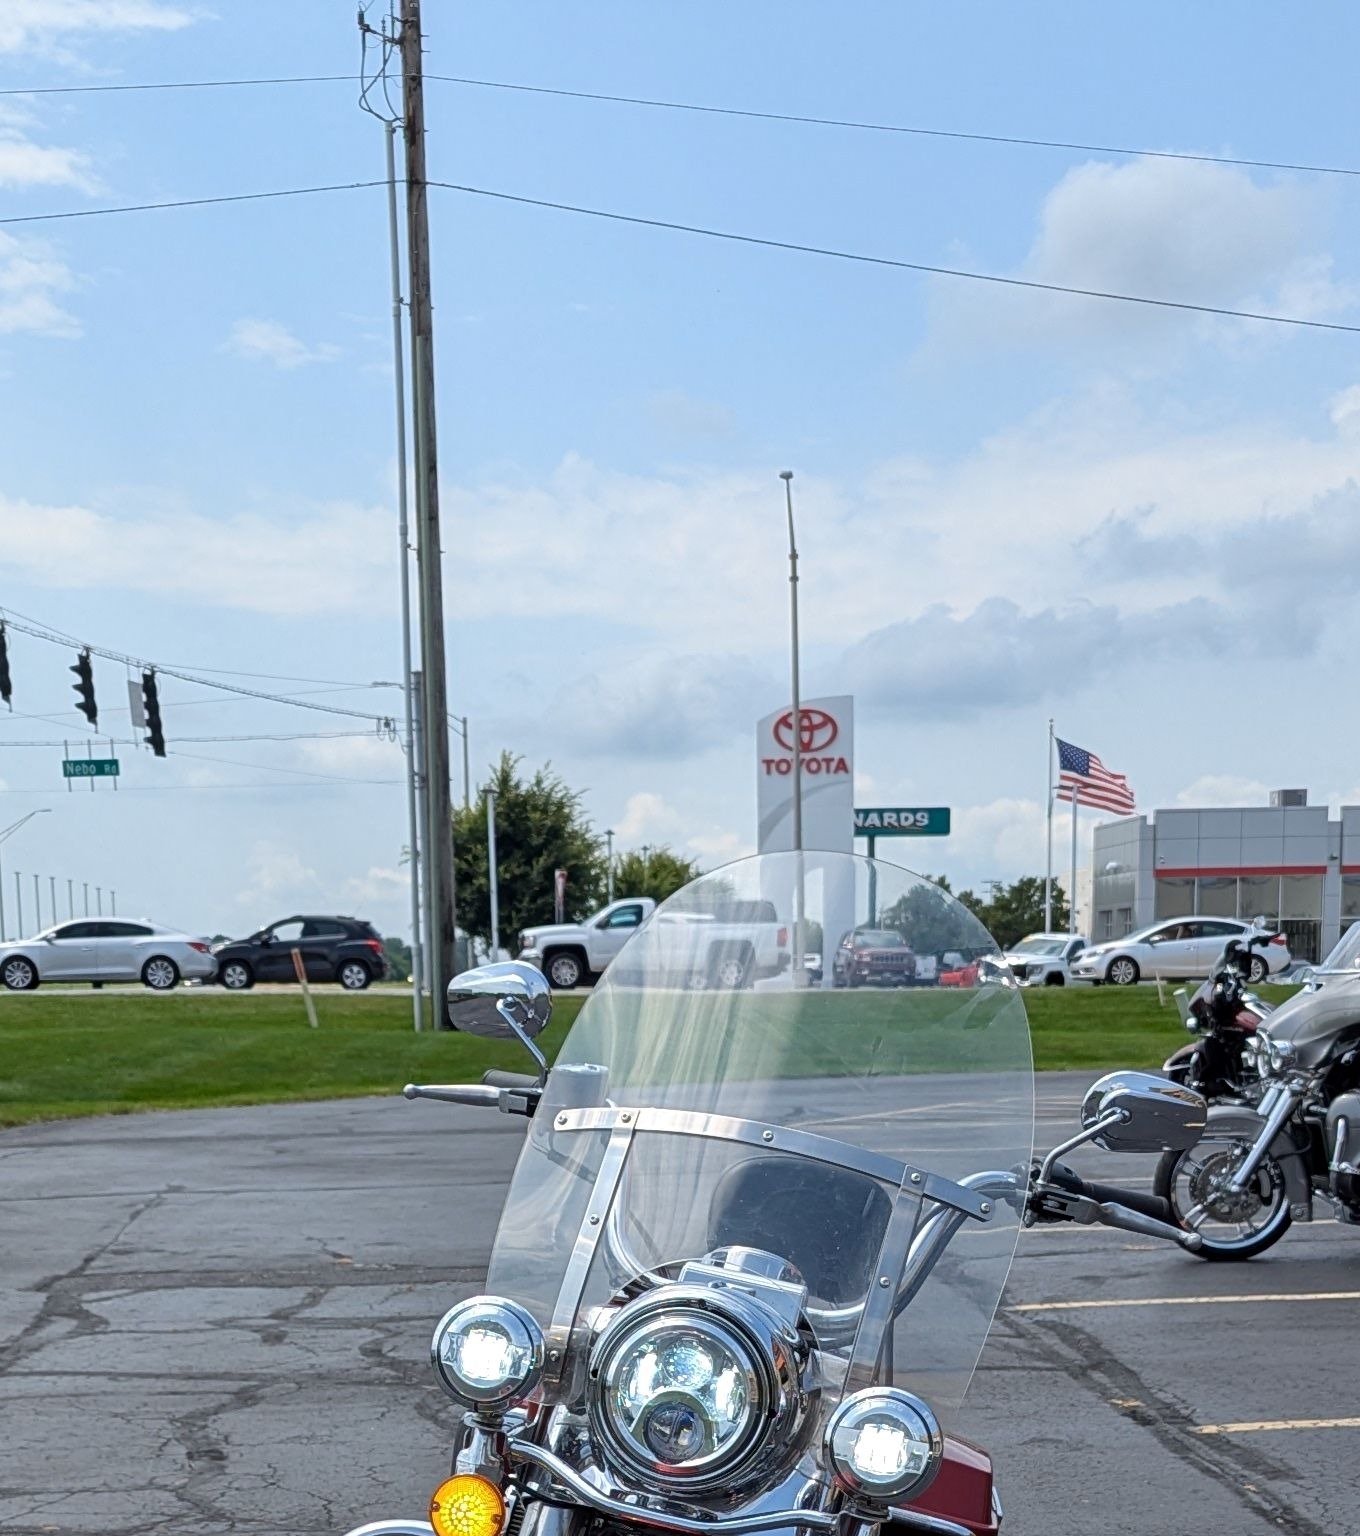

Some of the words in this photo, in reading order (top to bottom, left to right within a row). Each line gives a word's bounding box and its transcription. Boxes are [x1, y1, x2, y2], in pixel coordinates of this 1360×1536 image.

[66, 762, 97, 775] Nebo
[103, 763, 117, 774] Rd
[854, 812, 929, 828] NARDS
